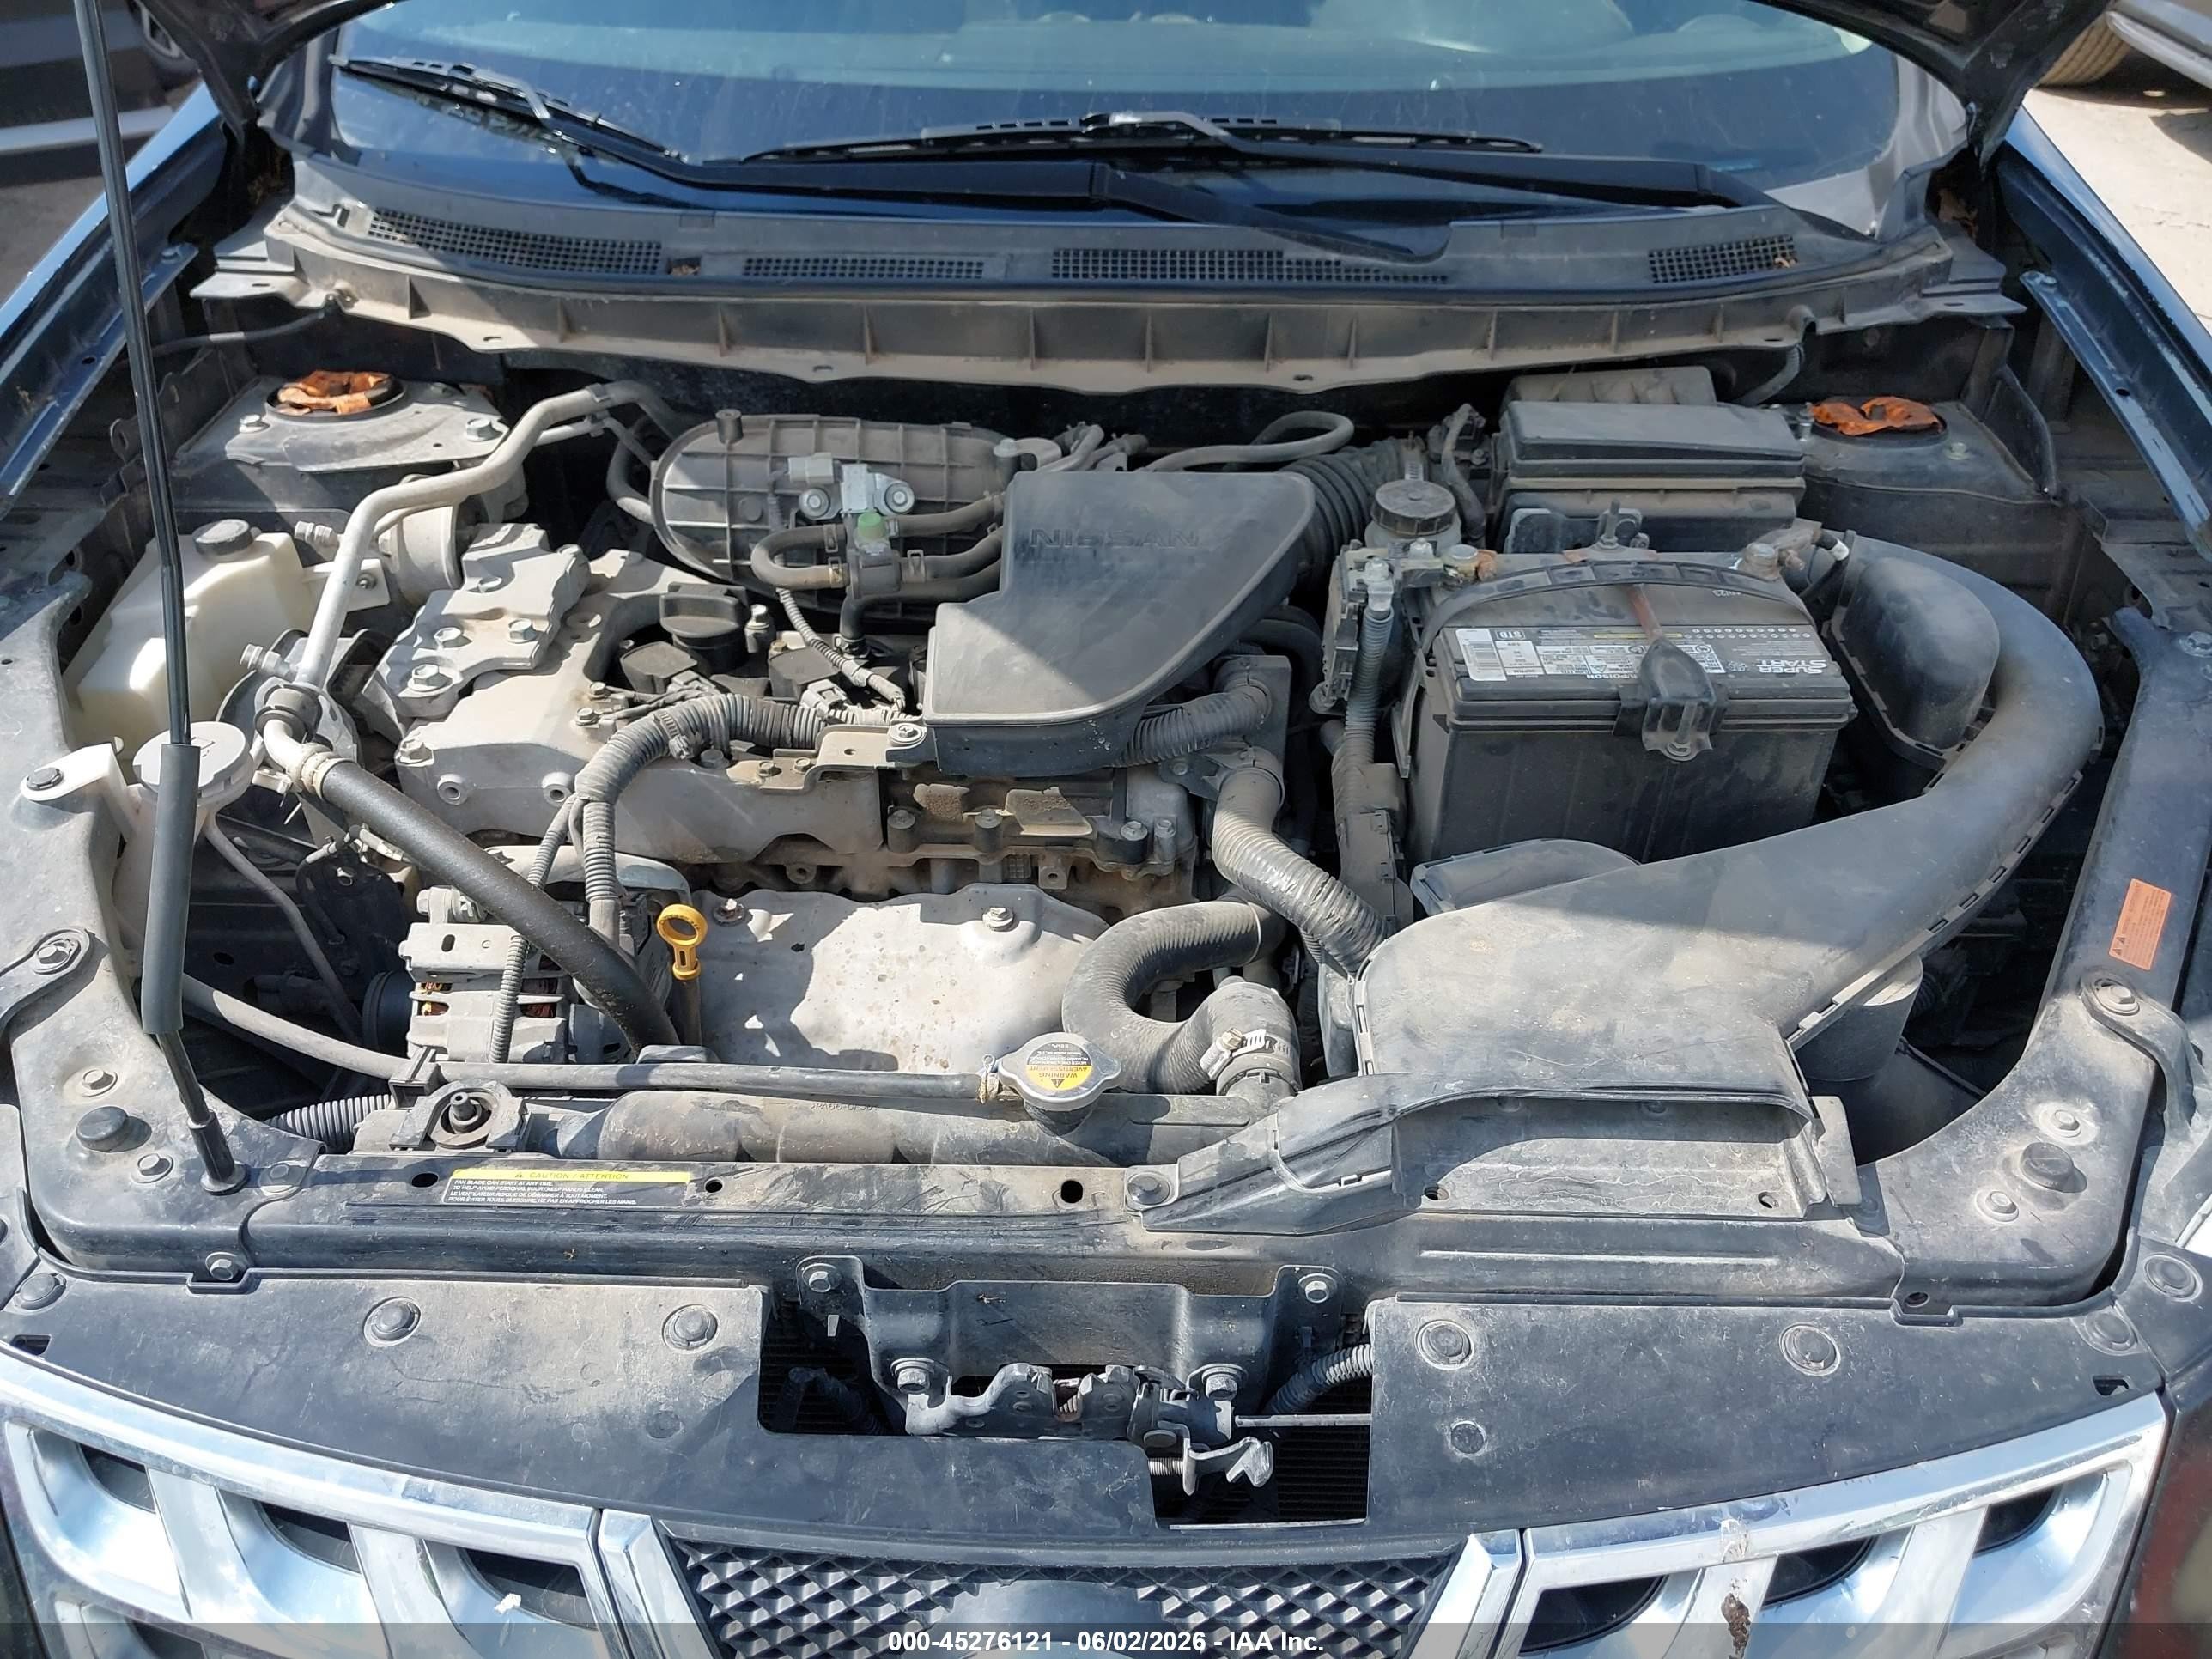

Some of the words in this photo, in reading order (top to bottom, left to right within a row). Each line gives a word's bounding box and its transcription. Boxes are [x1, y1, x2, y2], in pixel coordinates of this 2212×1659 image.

[1030, 528, 1200, 549] NISSAN
[1755, 659, 1827, 669] START
[1759, 665, 1823, 674] SUPER
